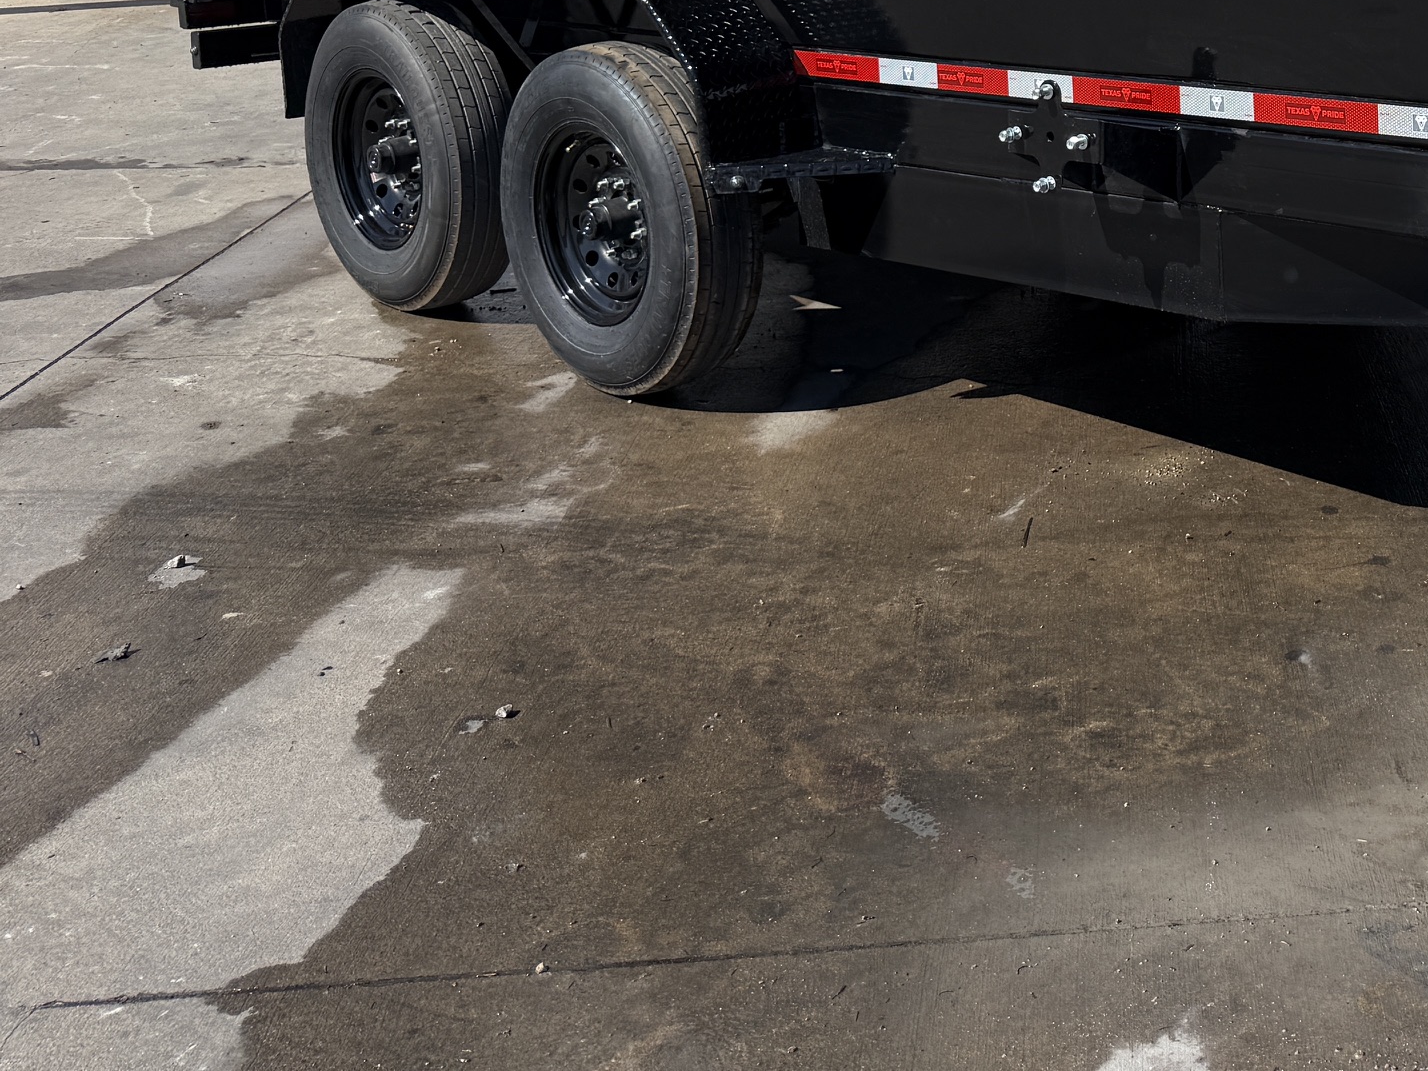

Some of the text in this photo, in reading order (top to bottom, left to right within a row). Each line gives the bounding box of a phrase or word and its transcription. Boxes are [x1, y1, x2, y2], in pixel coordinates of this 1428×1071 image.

[939, 73, 983, 83] TEXAS PRIDE
[1101, 88, 1151, 100] TEXAS PRIDE
[1287, 106, 1345, 119] TEXAS PRIDE
